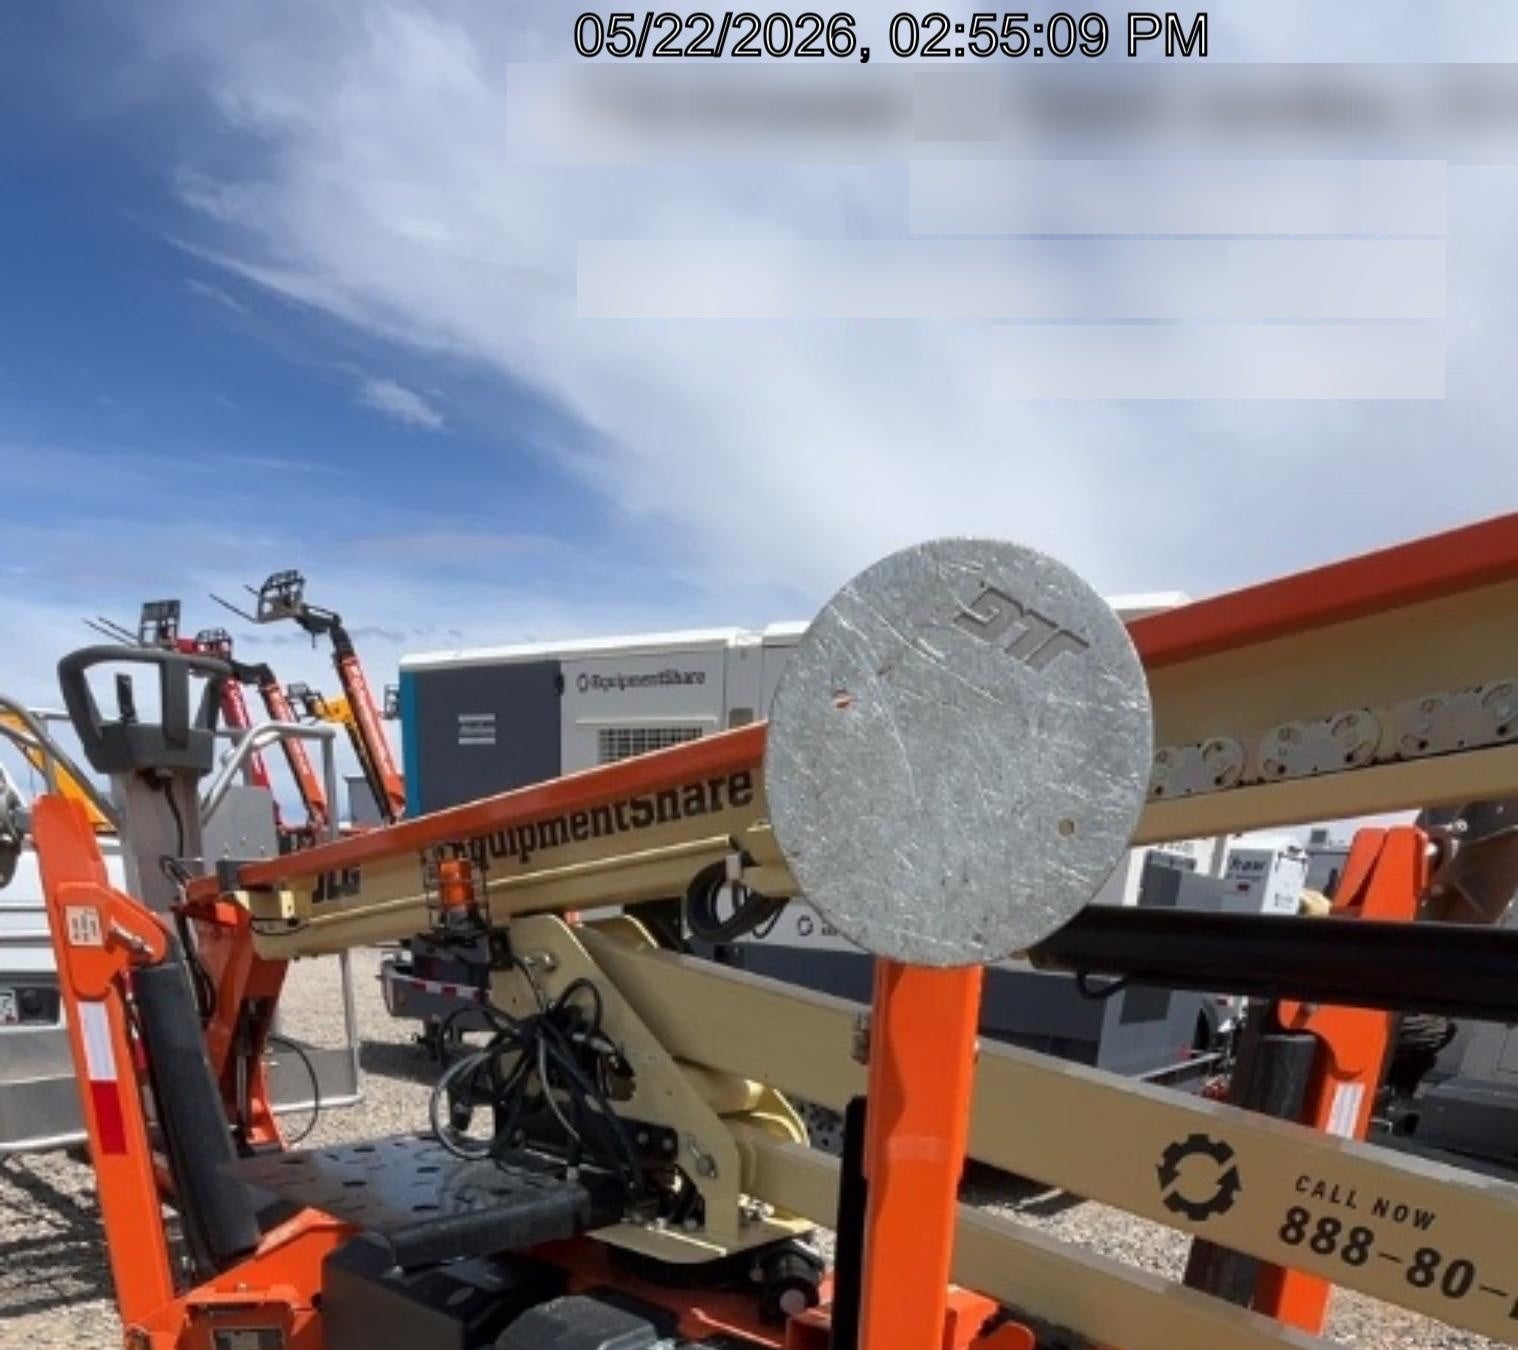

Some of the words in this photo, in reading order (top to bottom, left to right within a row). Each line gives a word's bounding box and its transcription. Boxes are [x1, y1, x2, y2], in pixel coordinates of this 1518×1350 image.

[954, 586, 1090, 671] JLG
[591, 669, 706, 692] EquipmentShare
[312, 867, 361, 904] JLG
[1295, 1175, 1358, 1209] CALL
[1371, 1197, 1436, 1231] NOW
[1279, 1206, 1518, 1320] 888-80-
